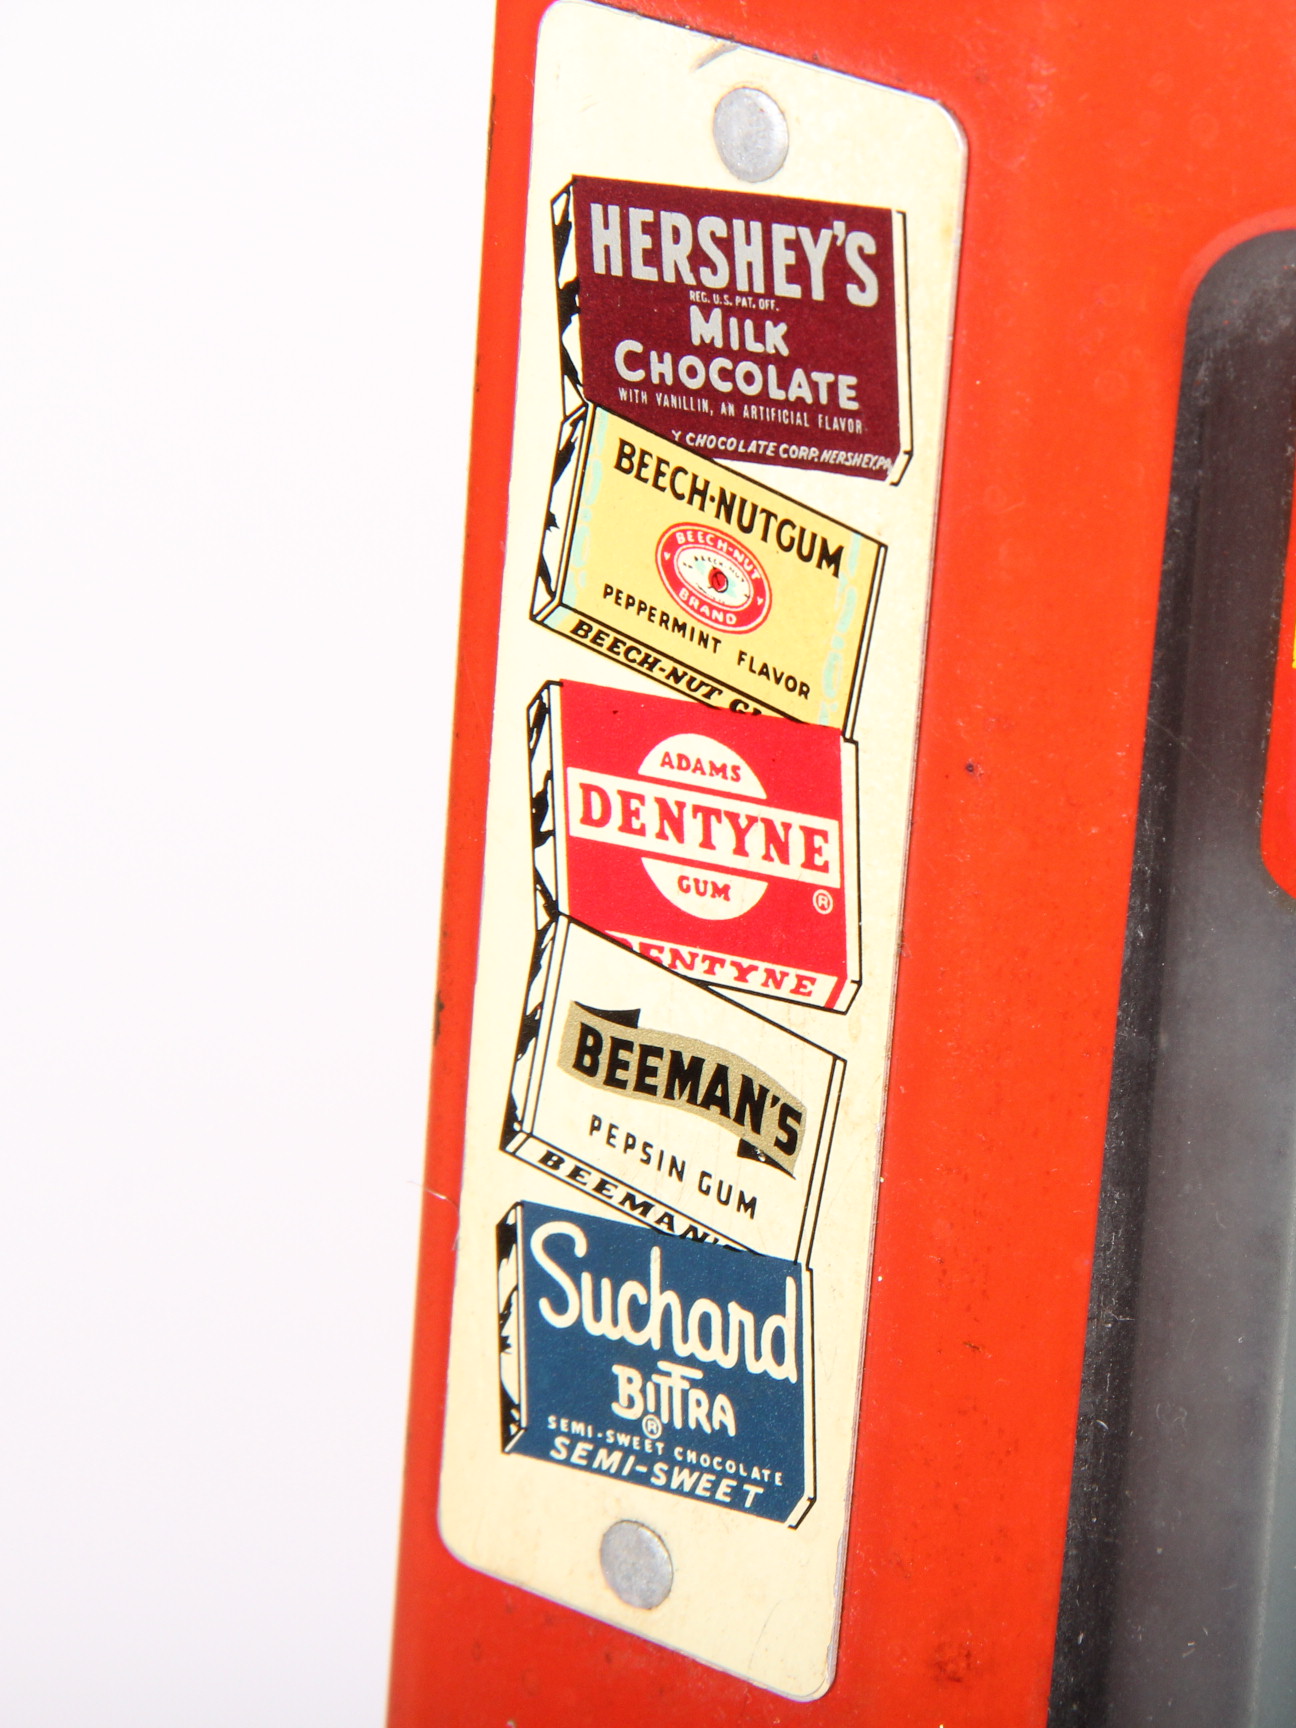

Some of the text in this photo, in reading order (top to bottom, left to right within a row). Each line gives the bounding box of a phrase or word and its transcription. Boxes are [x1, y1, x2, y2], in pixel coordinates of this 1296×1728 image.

[590, 202, 879, 308] HERSHEY'S
[689, 290, 711, 304] REG.
[735, 296, 757, 309] PAT.
[758, 298, 780, 311] OFF.
[689, 304, 789, 357] MILK
[614, 339, 860, 410] CHOCOLATE
[618, 387, 863, 434] WITH VANILLIN, AN ARTIFICIAL FLAVOR
[685, 432, 778, 457] CHOCOLATE
[675, 531, 761, 580] BEECH-NUT
[679, 587, 737, 625] BRAND
[570, 619, 723, 700] BEECH-NUT
[603, 584, 810, 700] PEPPERMINT FLAVOR
[660, 751, 742, 783] ADAMS
[579, 782, 831, 875] DENTYNE
[677, 875, 732, 902] GUM
[612, 936, 817, 997] ENTYNE
[572, 1022, 803, 1157] BEEMAN'S
[589, 1114, 758, 1220] PEPSIN GUM
[530, 1220, 798, 1384] Suchard
[549, 1436, 764, 1508] SEMI-SWEET
[674, 1446, 784, 1487] CHOCOLATE
